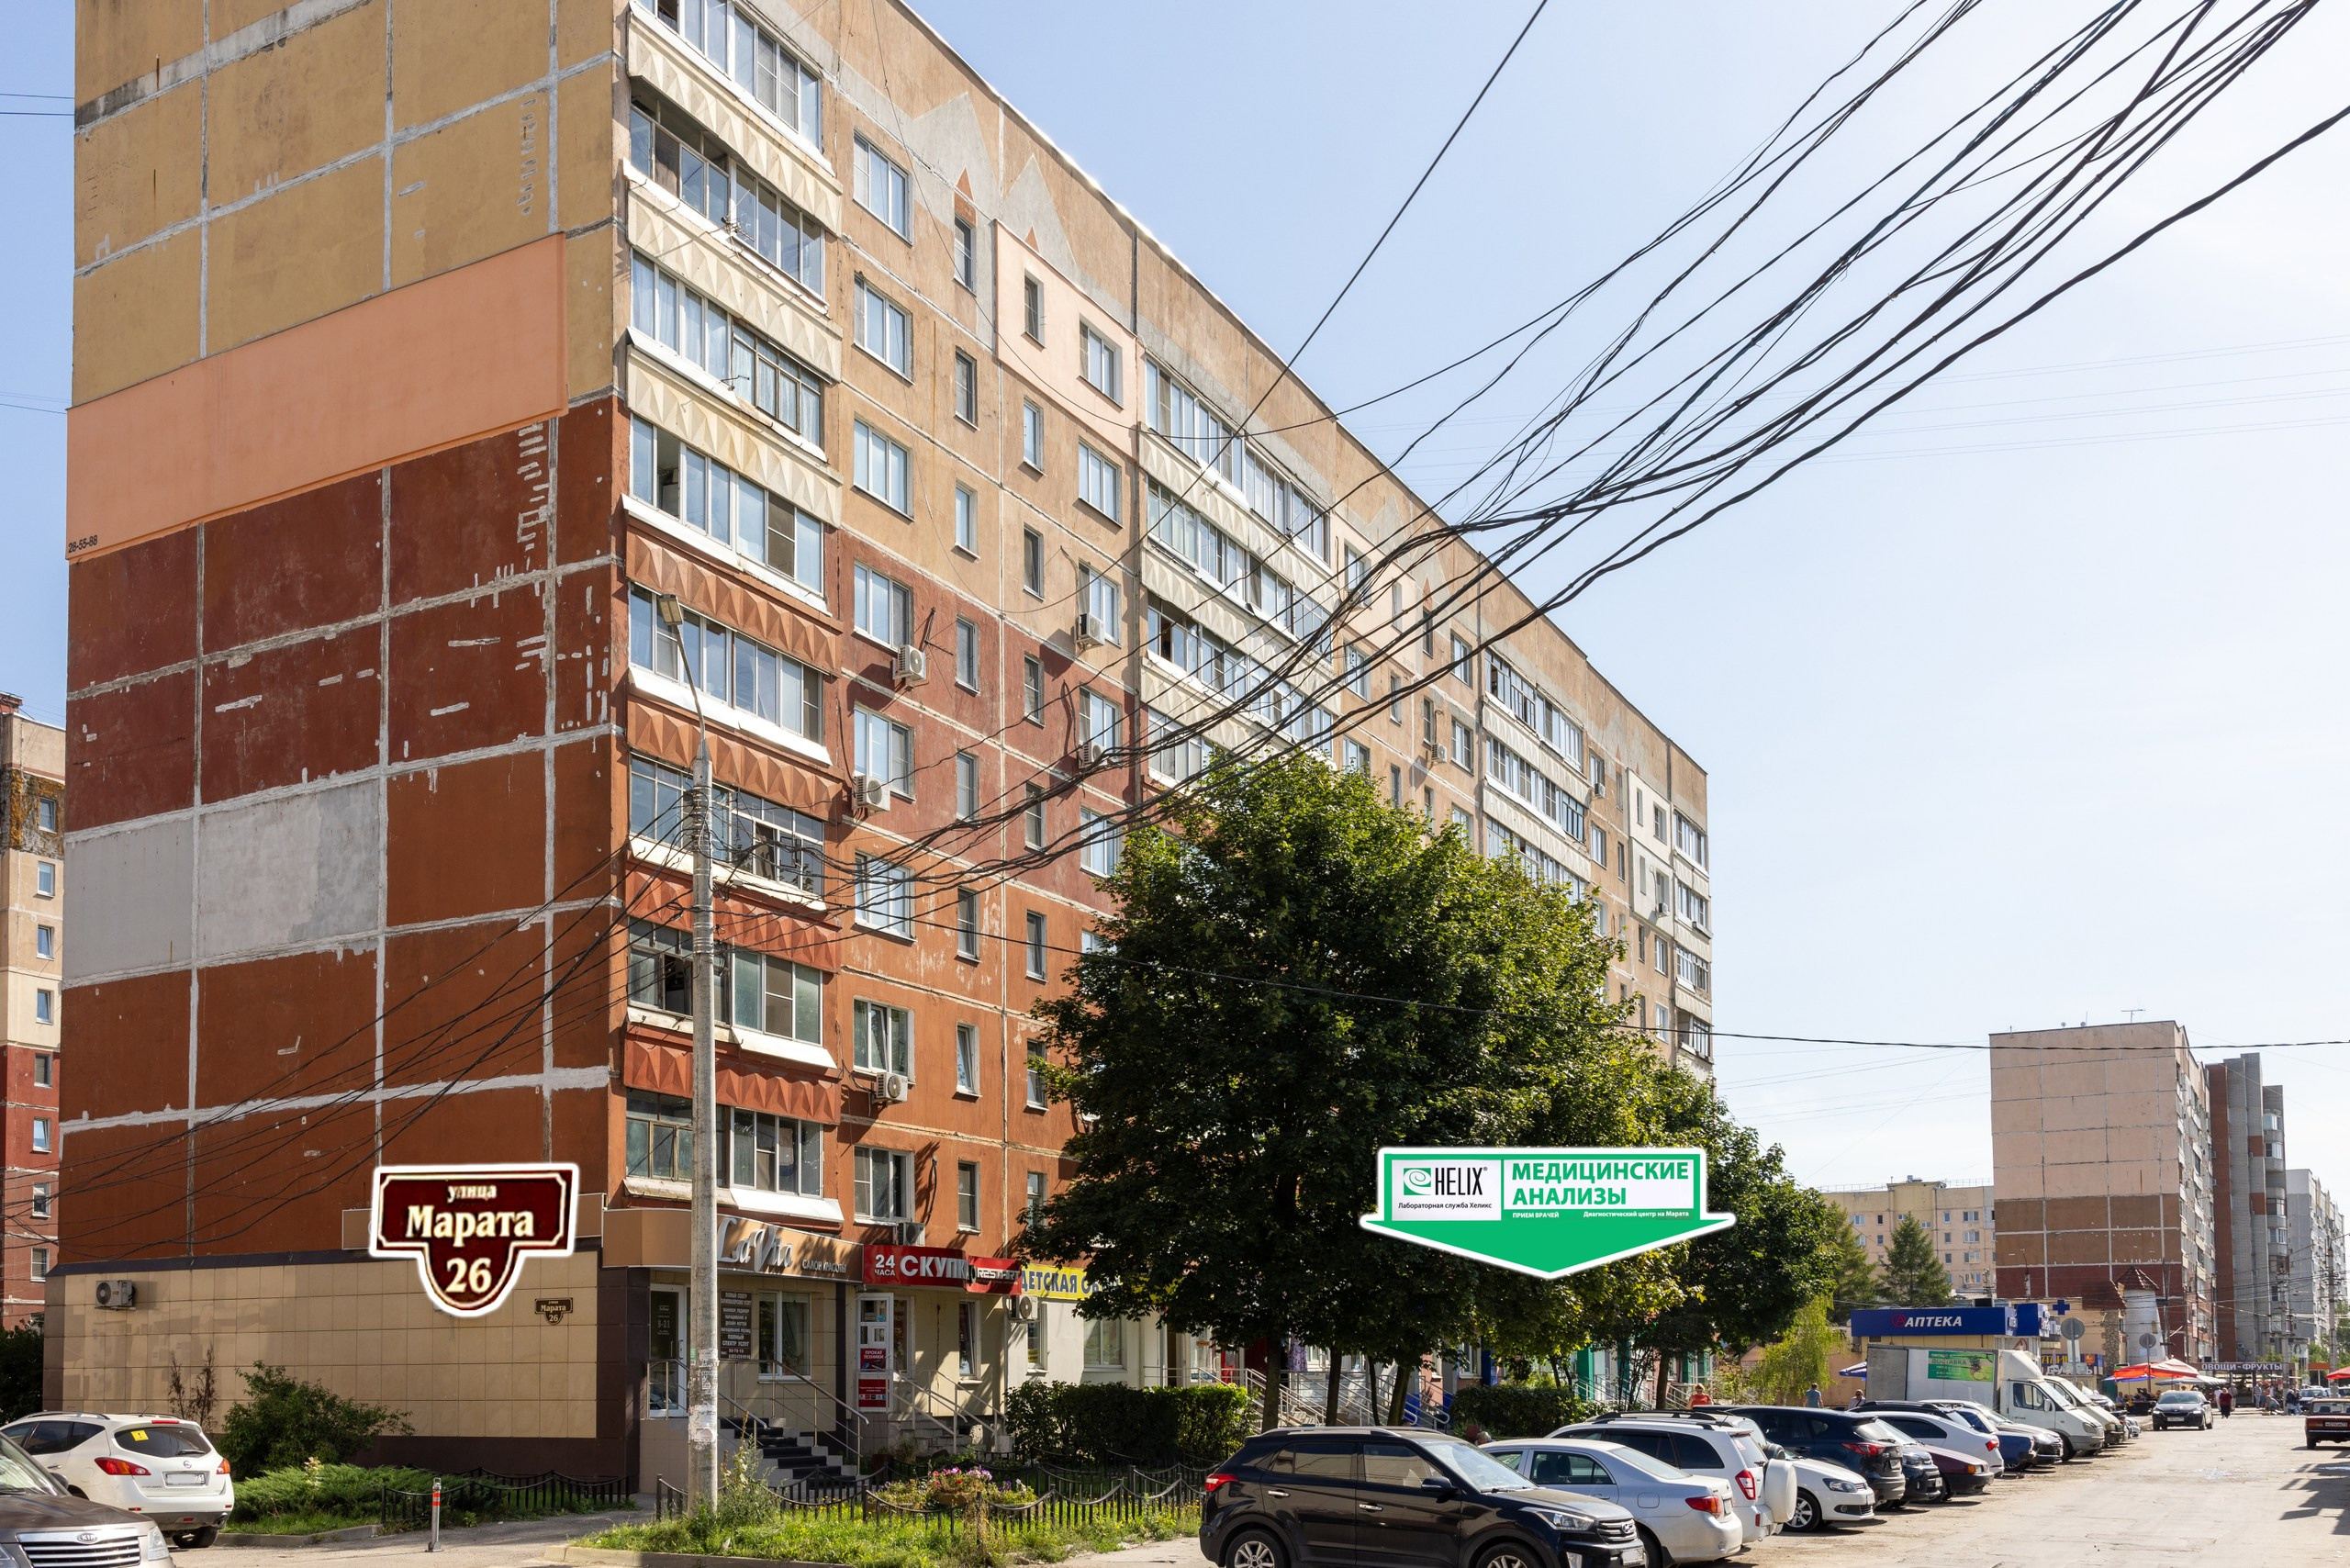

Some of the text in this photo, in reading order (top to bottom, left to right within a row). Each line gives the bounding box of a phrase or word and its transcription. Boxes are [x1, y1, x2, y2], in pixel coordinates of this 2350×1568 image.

[68, 534, 98, 554] 28-55-88
[801, 1260, 822, 1271] САЛОН
[875, 1254, 896, 1269] 24
[977, 1267, 1021, 1281] RESTART
[1021, 1270, 1078, 1294] ДЕТСКАЯ
[541, 1305, 566, 1313] Марата
[1904, 1316, 1963, 1327] АПТЕКА
